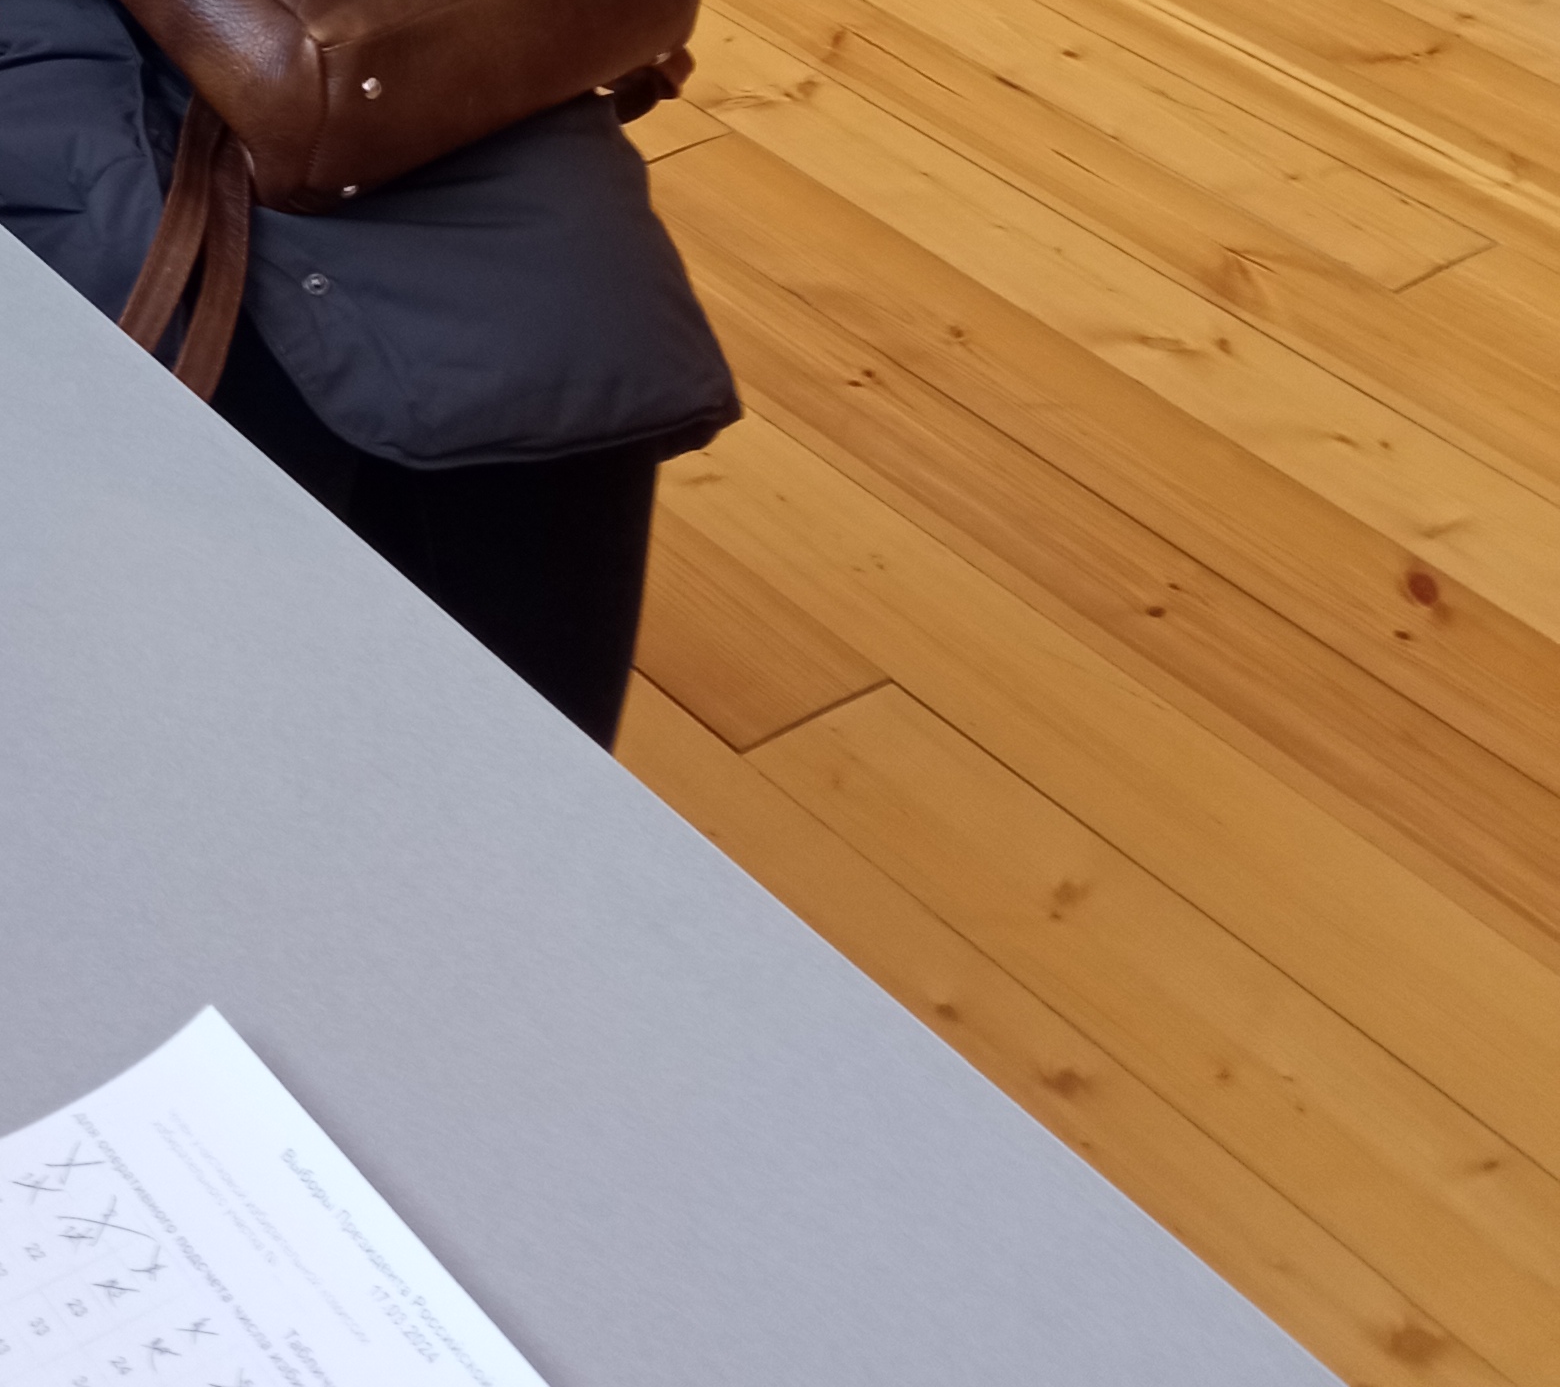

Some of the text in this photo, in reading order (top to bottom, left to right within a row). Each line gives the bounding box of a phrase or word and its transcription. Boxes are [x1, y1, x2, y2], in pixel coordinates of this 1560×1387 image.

[71, 1113, 100, 1138] для
[96, 1139, 177, 1234] оперативного
[174, 1235, 234, 1303] подсчета
[233, 1304, 272, 1351] числа
[279, 1147, 334, 1211] Выборы
[335, 1208, 410, 1297] Президента
[22, 1241, 47, 1262] 22
[64, 1298, 89, 1318] 23
[29, 1316, 51, 1336] 33
[371, 1285, 439, 1363] 17.03.2024
[108, 1355, 134, 1376] 24
